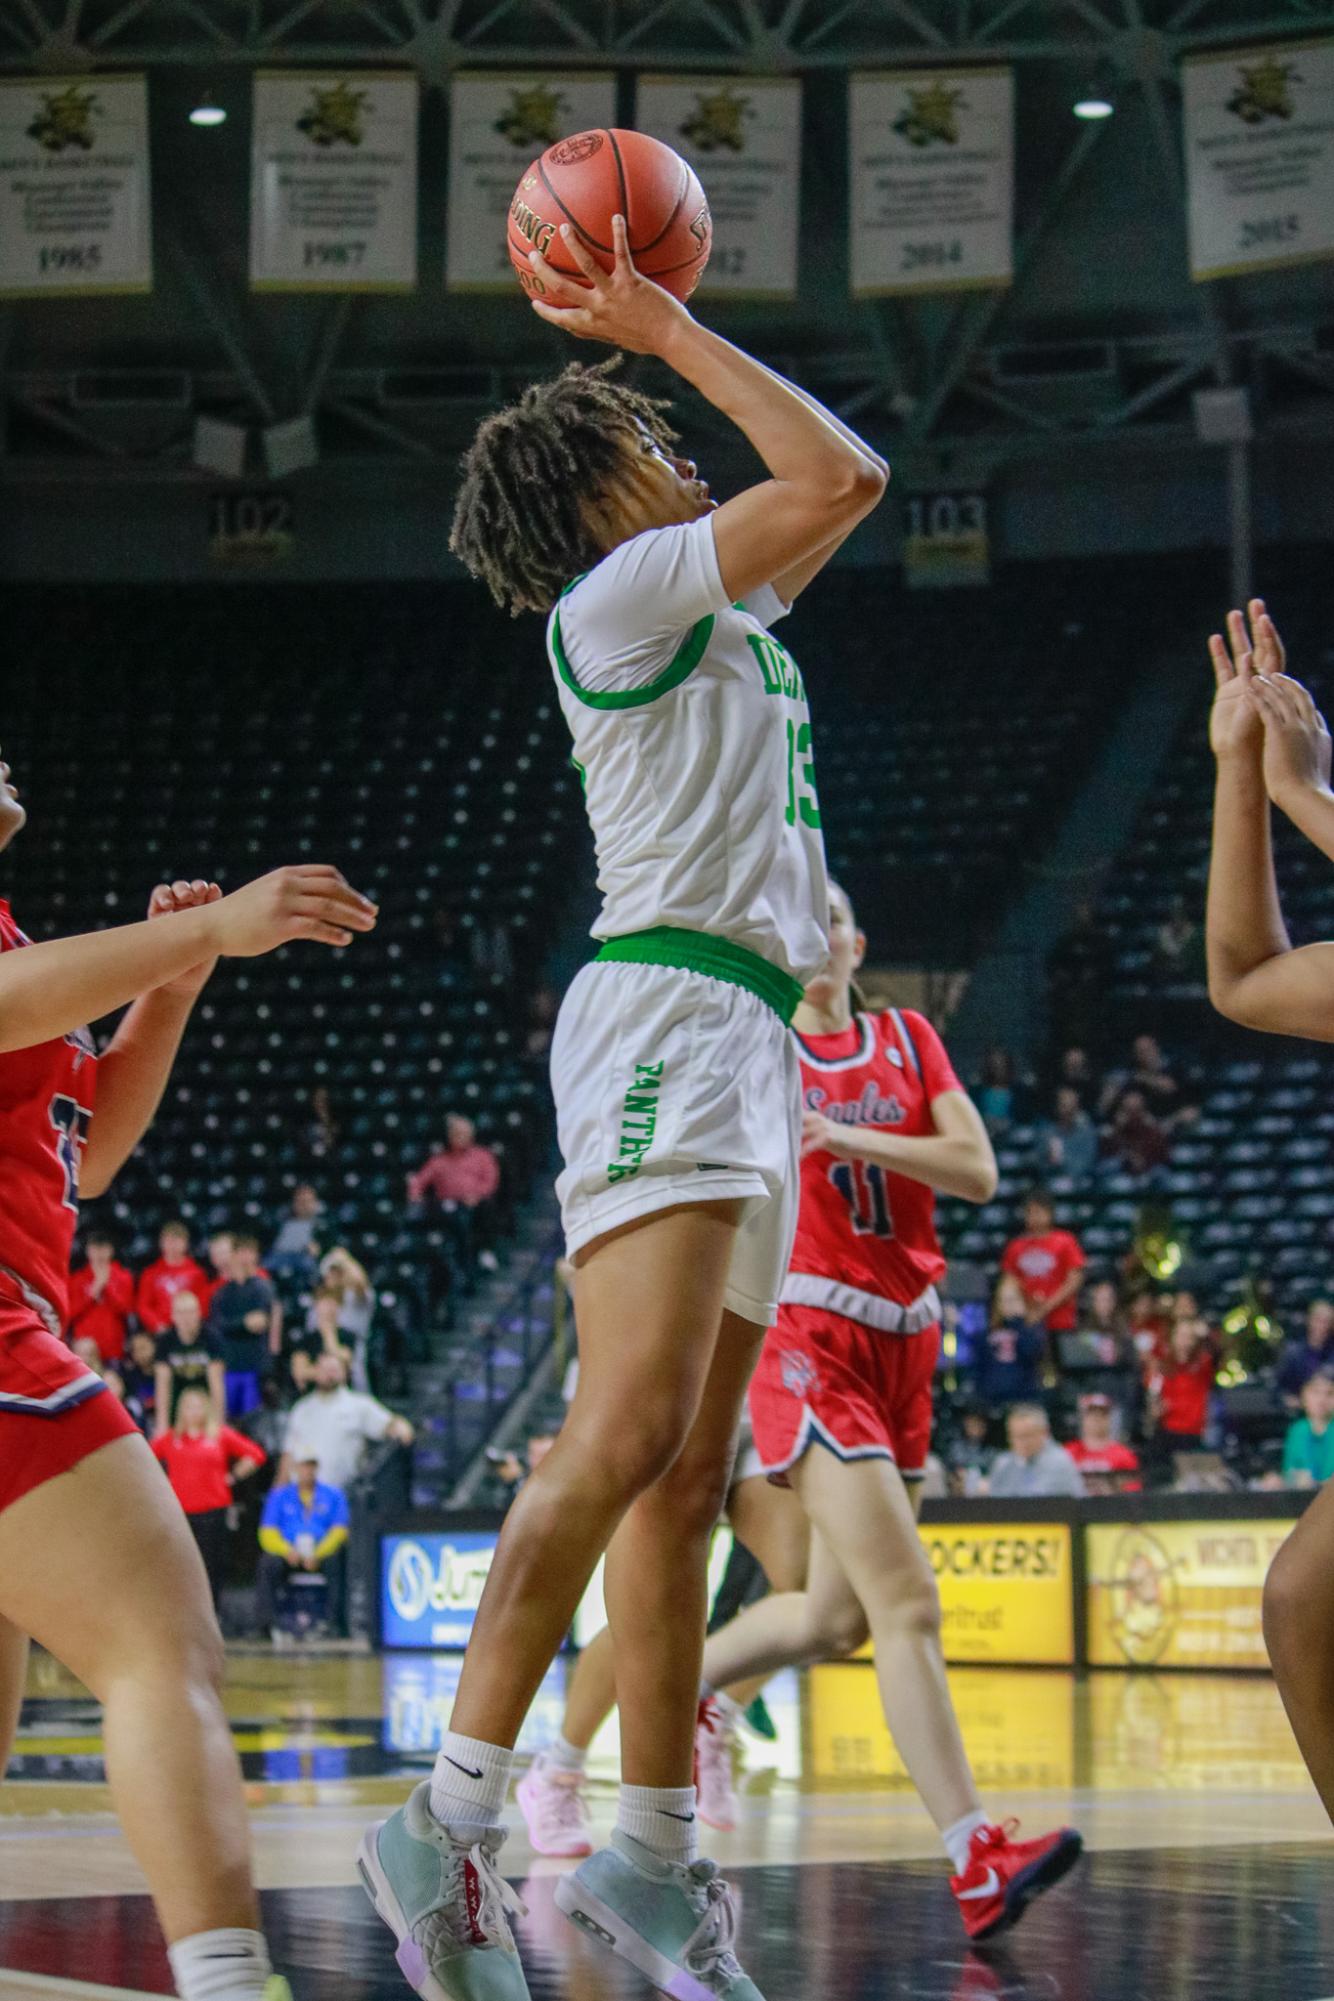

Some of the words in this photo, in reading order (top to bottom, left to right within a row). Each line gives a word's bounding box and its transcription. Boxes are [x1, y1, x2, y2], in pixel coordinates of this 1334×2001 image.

[511, 198, 557, 257] DING
[211, 496, 290, 541] 102
[908, 495, 987, 541] 103
[928, 1537, 1063, 1578] OCKERS!
